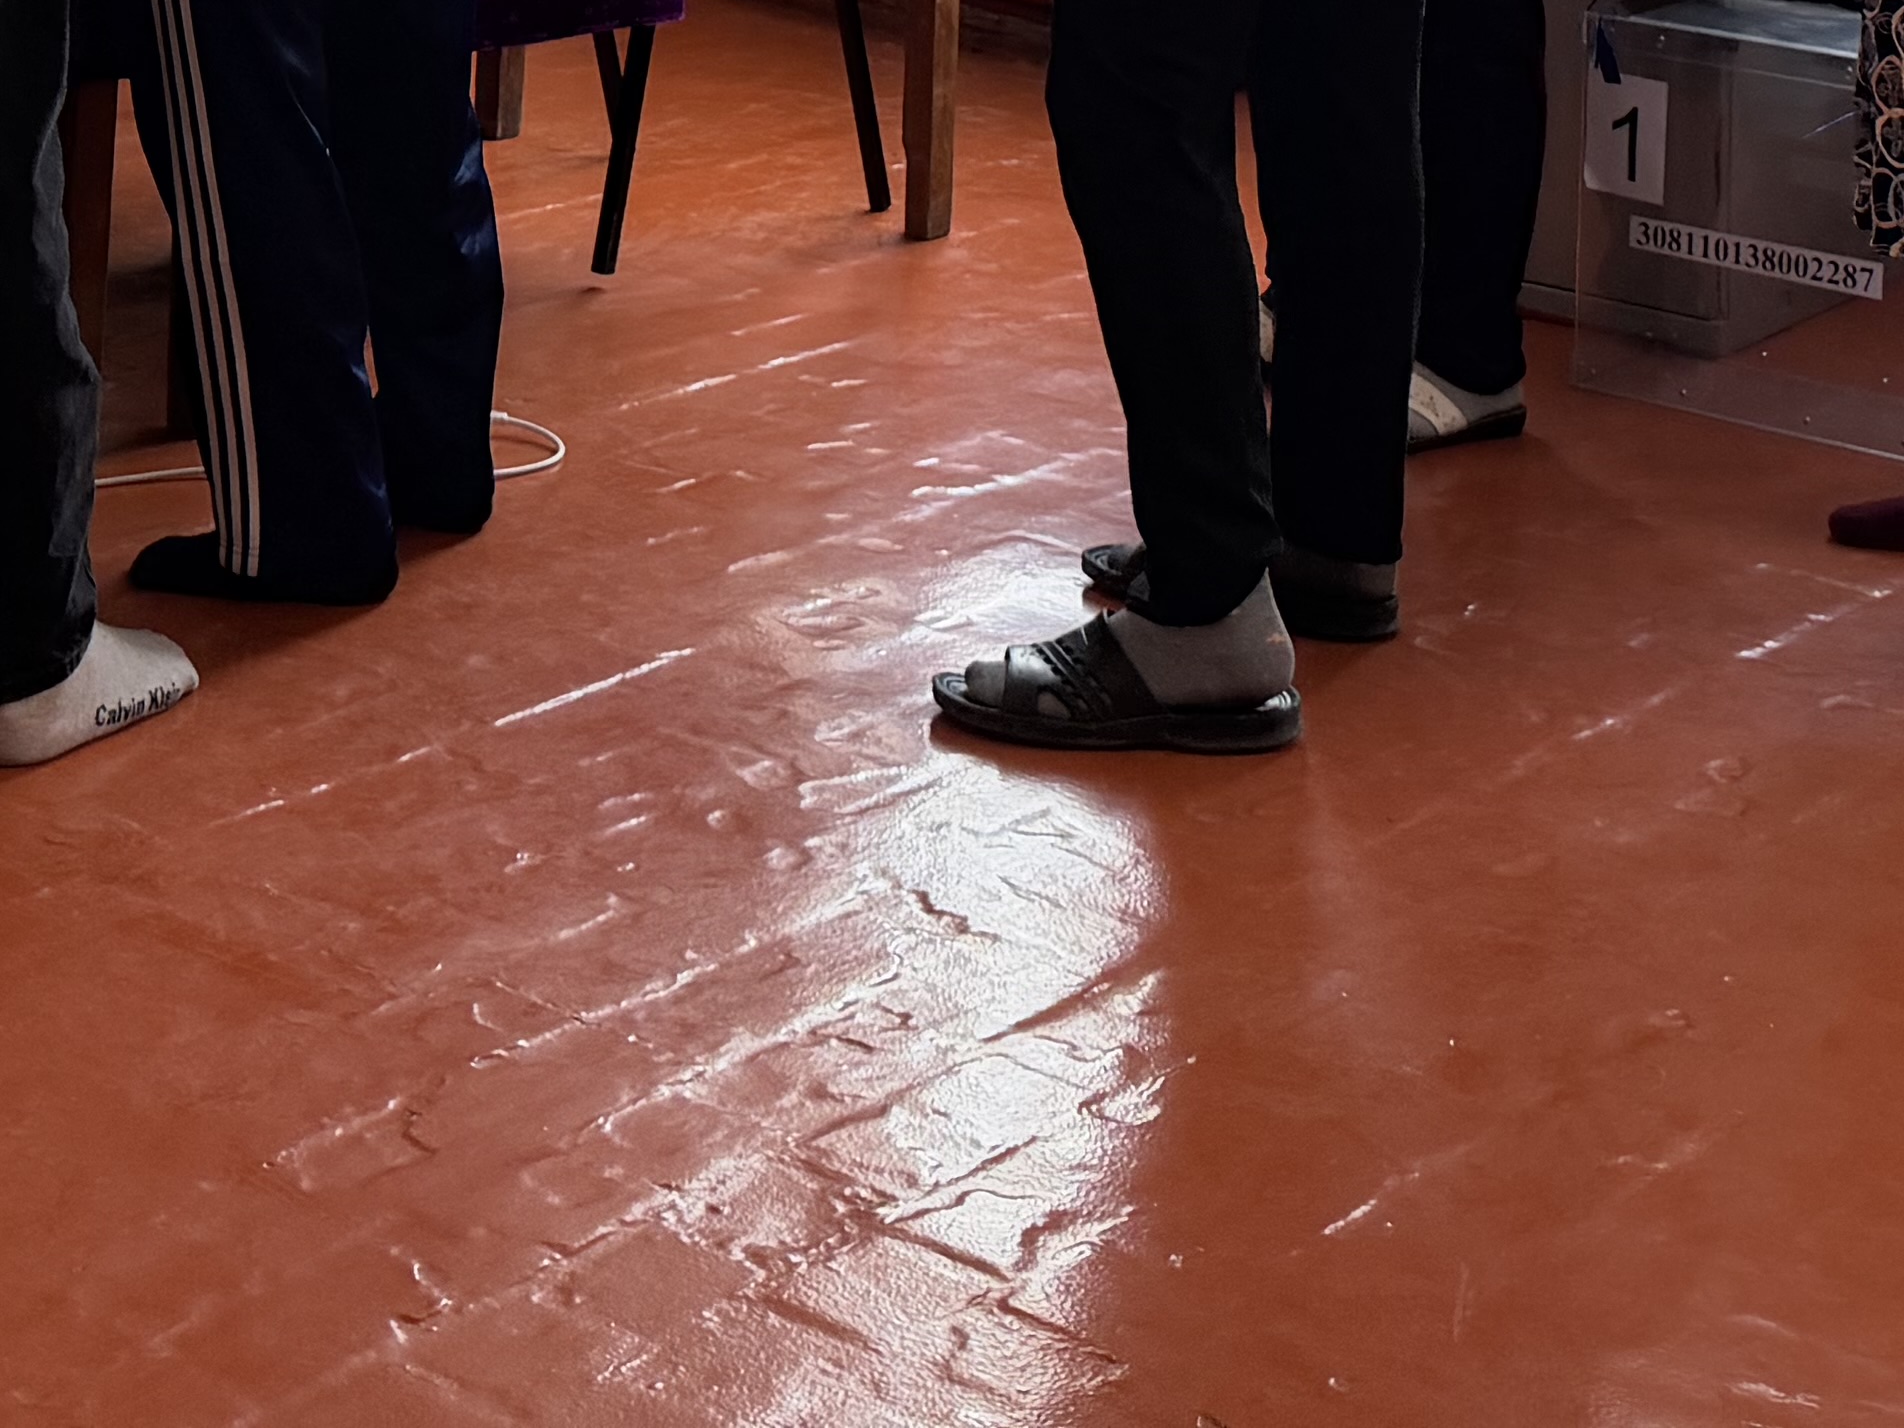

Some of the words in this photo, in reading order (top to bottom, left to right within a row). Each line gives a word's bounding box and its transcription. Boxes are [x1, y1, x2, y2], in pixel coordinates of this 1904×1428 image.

[1611, 106, 1639, 183] 1
[1635, 220, 1876, 293] 308110138002287
[94, 696, 146, 727] Calvin
